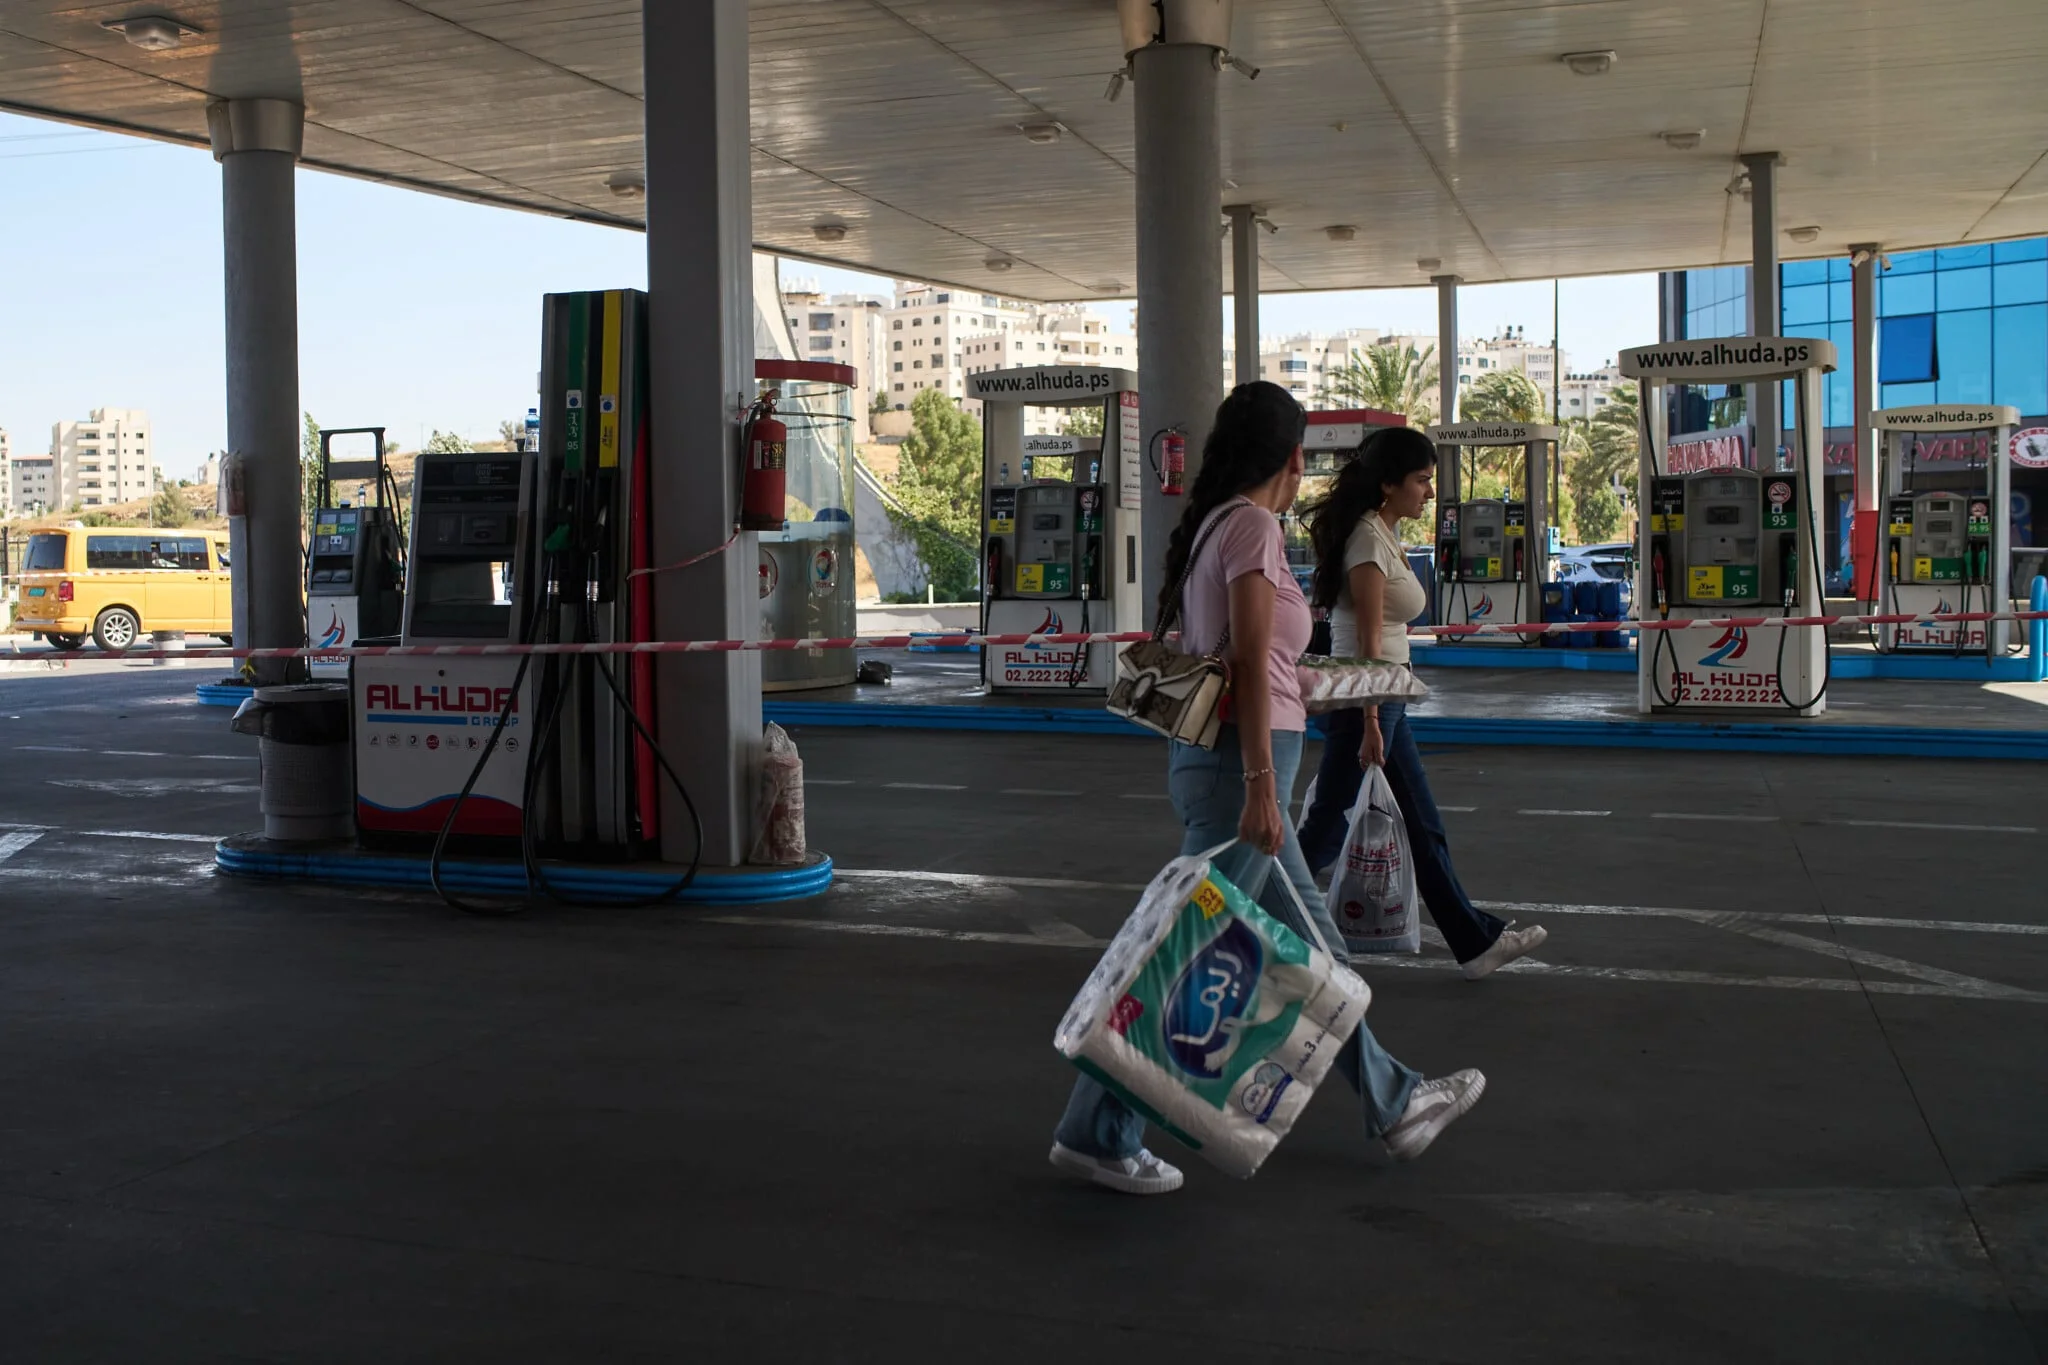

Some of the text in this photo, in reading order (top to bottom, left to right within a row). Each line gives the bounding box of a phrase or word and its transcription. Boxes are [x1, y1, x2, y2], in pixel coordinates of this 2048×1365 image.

[1637, 342, 1809, 369] www.alhuda.ps
[976, 369, 1110, 393] www.alhuda.ps
[1886, 411, 1994, 424] www.alhuda.ps
[1437, 426, 1526, 441] www.alhuda.ps
[567, 440, 579, 450] 95
[1024, 439, 1073, 452] .alhuda.ps
[1772, 515, 1788, 526] 95
[1934, 571, 1960, 579] 95 95
[1050, 580, 1063, 590] 95
[1732, 584, 1748, 596] 95
[1672, 672, 1780, 687] AL HUDA
[1198, 887, 1218, 908] 32
[1171, 948, 1244, 1047] ريما
[1304, 1040, 1317, 1053] 3
